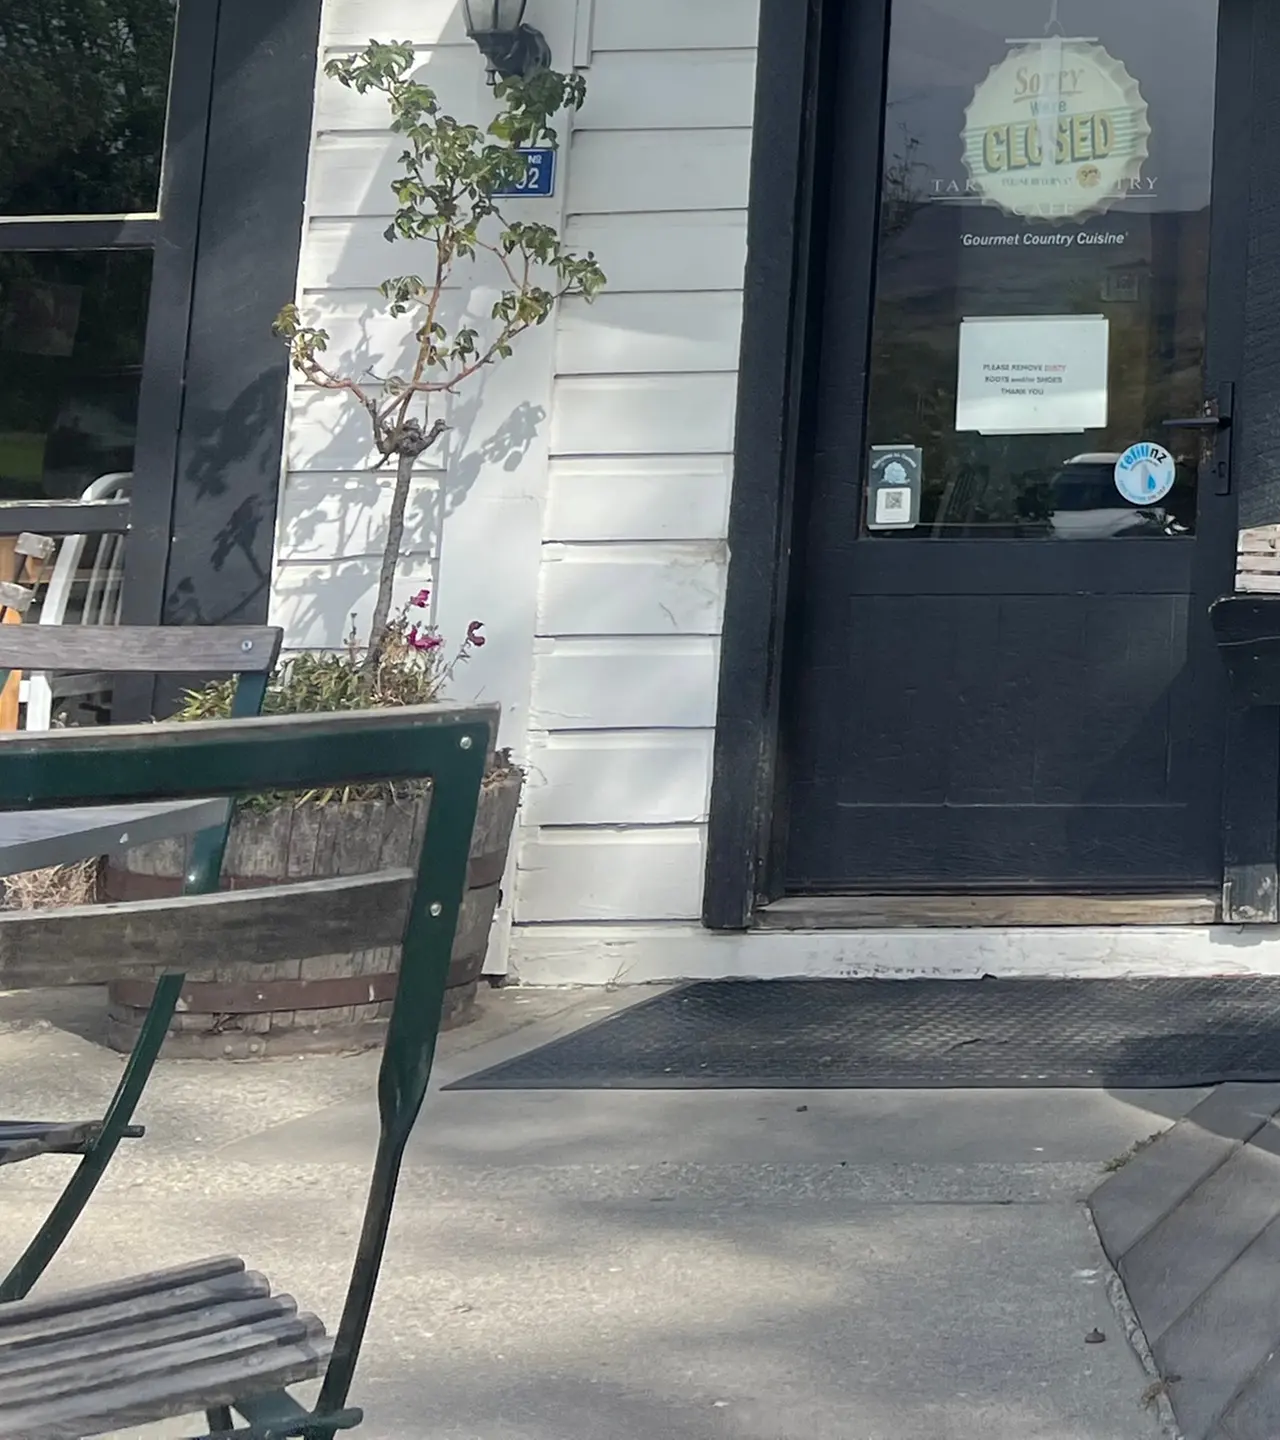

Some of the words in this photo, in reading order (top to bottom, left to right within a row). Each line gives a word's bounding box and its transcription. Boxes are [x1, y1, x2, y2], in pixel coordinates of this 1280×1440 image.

[1014, 65, 1085, 97] Sorry
[982, 112, 1115, 173] CLOSED
[1023, 232, 1075, 247] Country
